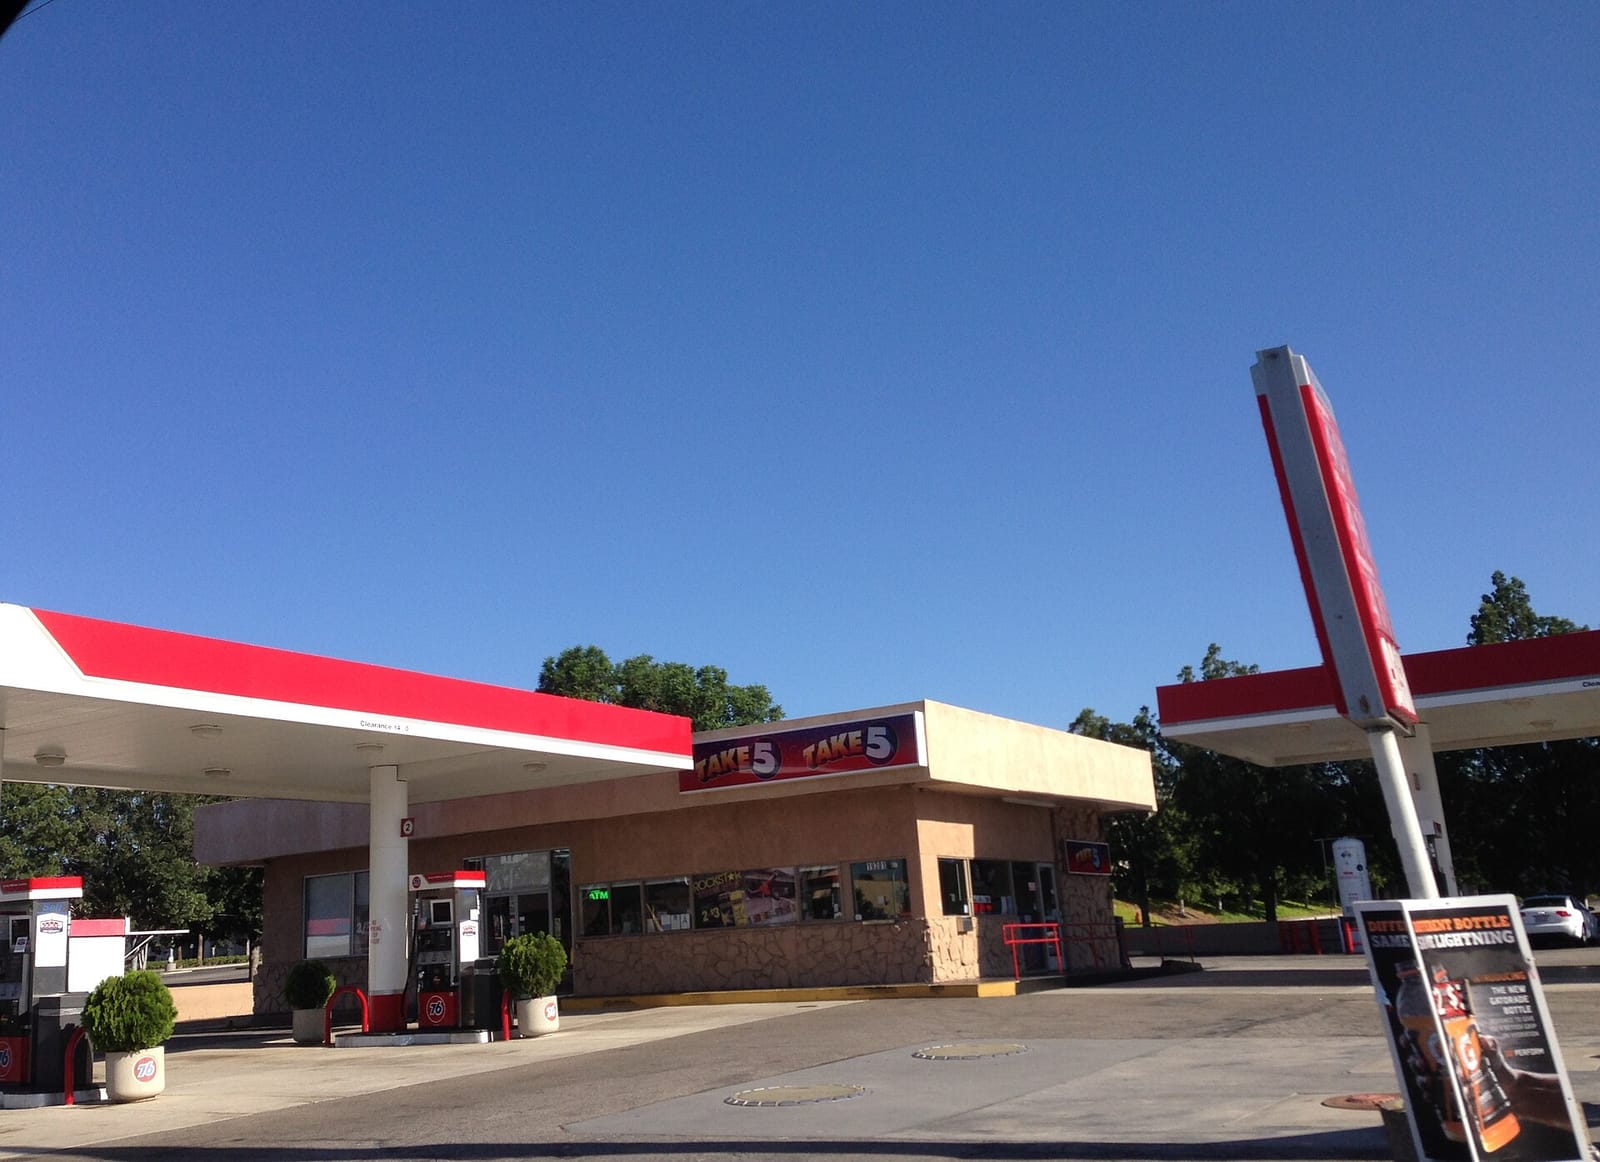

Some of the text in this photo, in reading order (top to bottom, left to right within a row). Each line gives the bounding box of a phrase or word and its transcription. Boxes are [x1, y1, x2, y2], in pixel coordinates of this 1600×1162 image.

[360, 720, 392, 730] Clearance
[803, 726, 892, 769] TAKE 5
[696, 742, 776, 782] TAKE 5
[405, 823, 411, 832] 2
[589, 891, 609, 900] ATM
[1455, 915, 1510, 930] BOTTLE
[1371, 934, 1410, 948] SAME
[1437, 930, 1515, 949] LIGHTNING
[1491, 984, 1527, 994] THE NEW
[429, 1000, 443, 1015] 76
[1503, 1005, 1533, 1015] BOTTLE
[136, 1060, 155, 1078] 76
